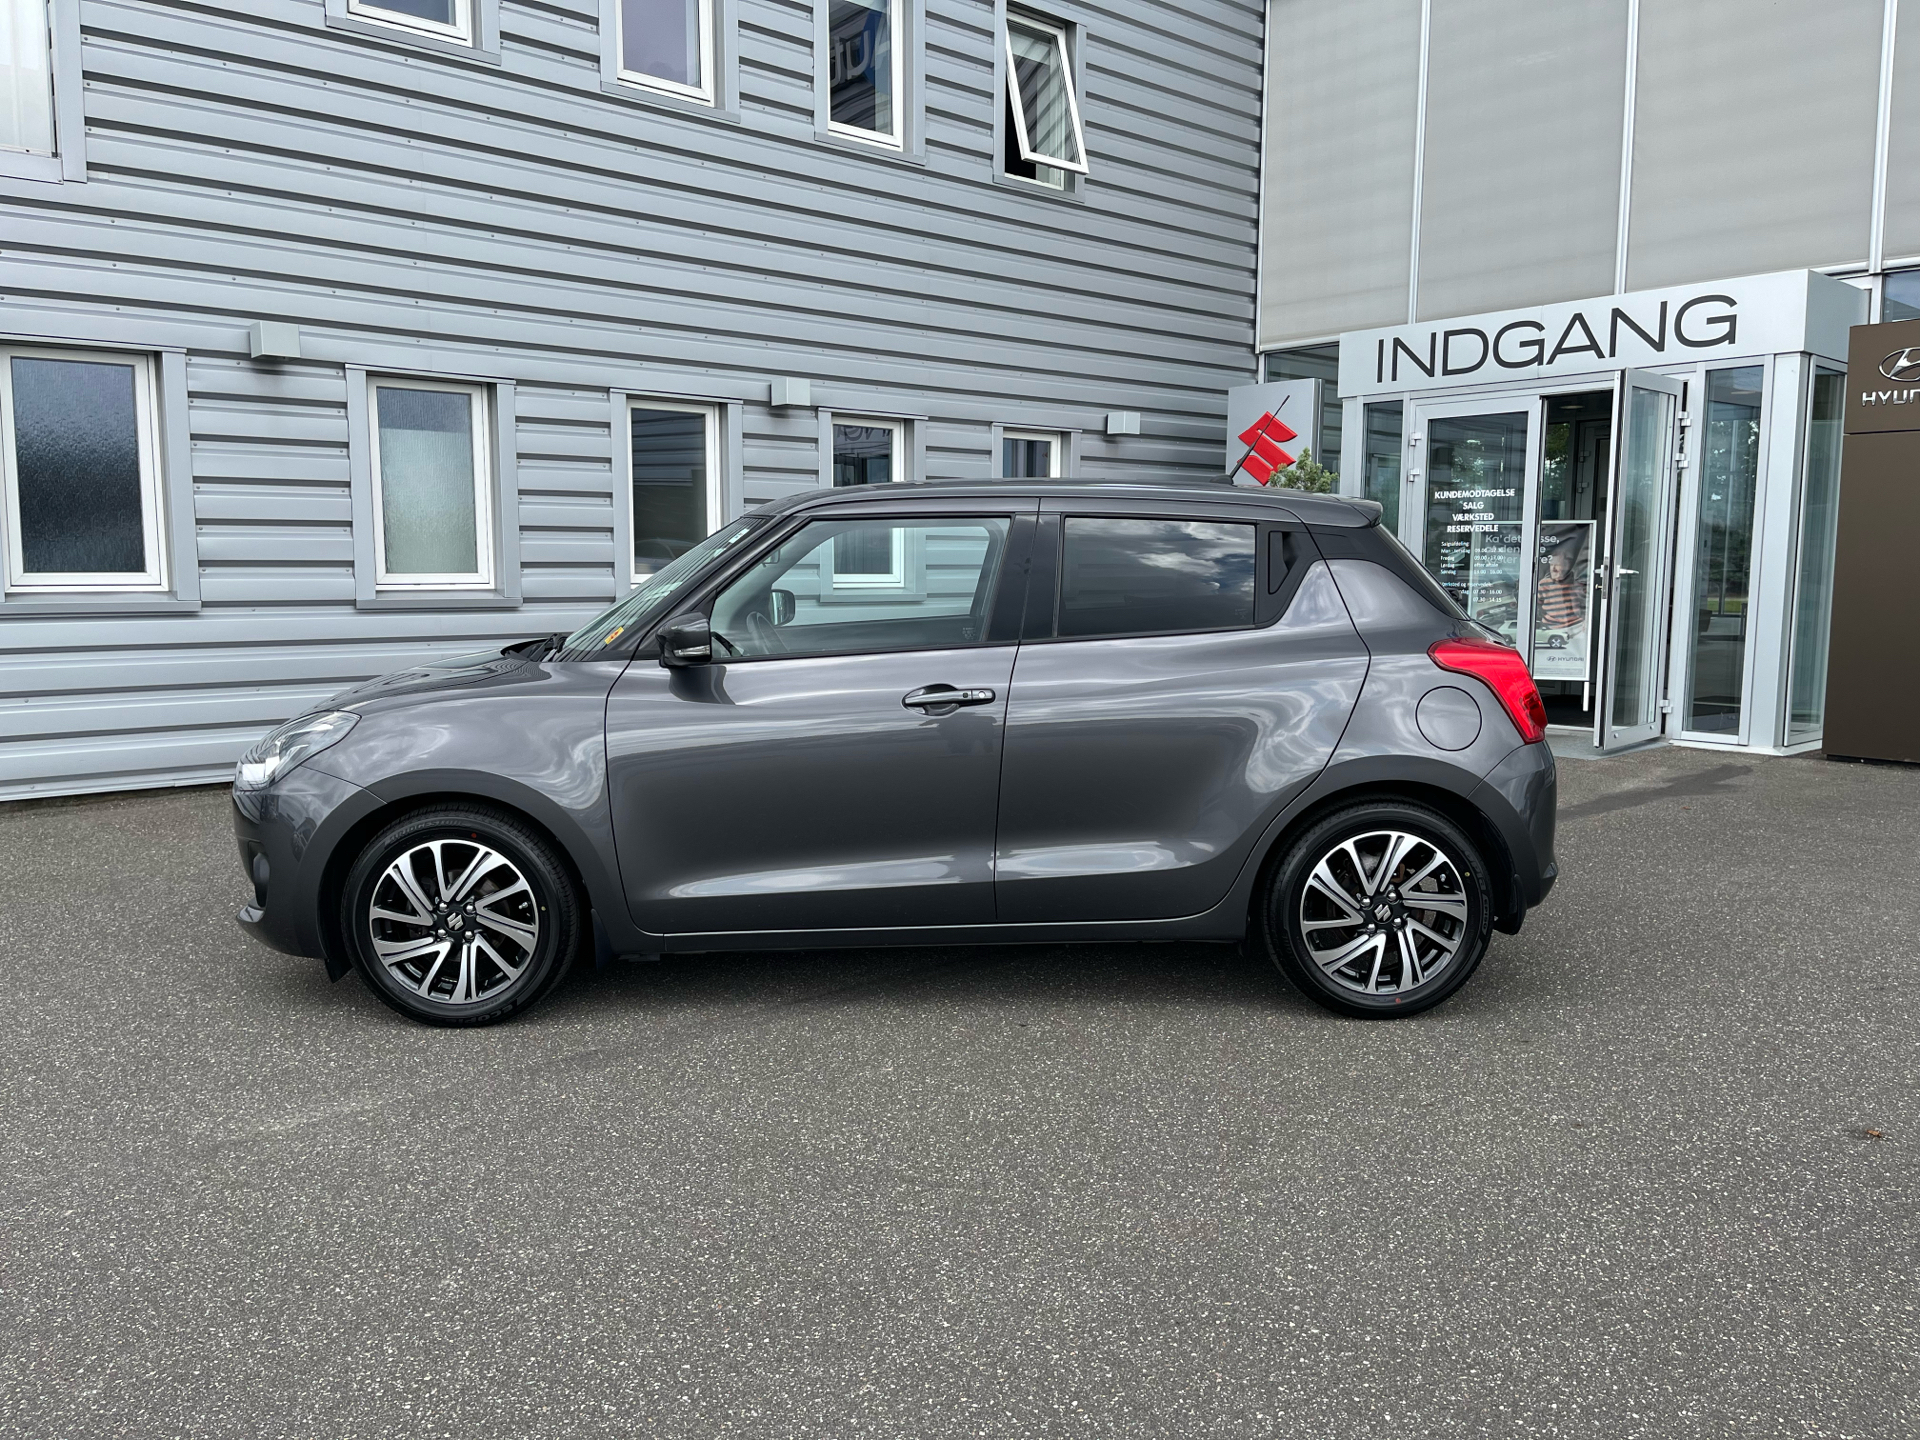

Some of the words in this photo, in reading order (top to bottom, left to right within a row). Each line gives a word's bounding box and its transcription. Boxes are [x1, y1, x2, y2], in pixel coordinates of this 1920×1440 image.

[1376, 294, 1738, 383] INDGANG
[1434, 489, 1515, 499] KUNDEMODTAGELSE
[1462, 501, 1485, 510] SALG
[1452, 513, 1494, 521] VÆRKSTED
[1446, 524, 1499, 533] RESERVEDELE
[1485, 534, 1503, 543] Ka'
